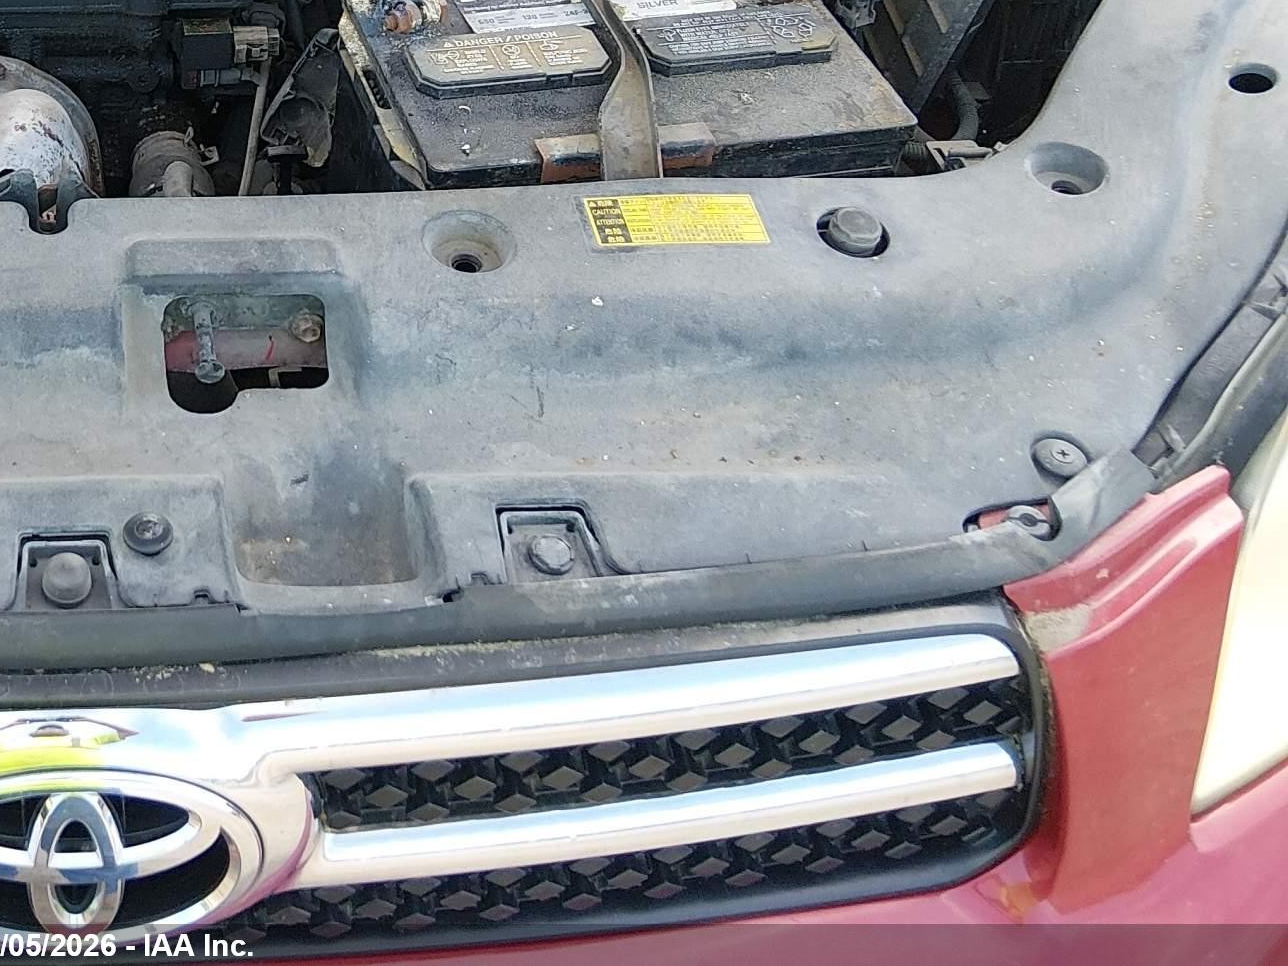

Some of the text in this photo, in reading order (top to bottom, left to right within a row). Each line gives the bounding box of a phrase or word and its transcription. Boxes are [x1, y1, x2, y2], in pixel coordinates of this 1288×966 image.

[637, 0, 679, 10] SILVER
[455, 37, 502, 47] DANGER
[514, 31, 559, 42] POISON
[592, 208, 621, 216] CAUTION
[596, 218, 625, 226] ATTENTION
